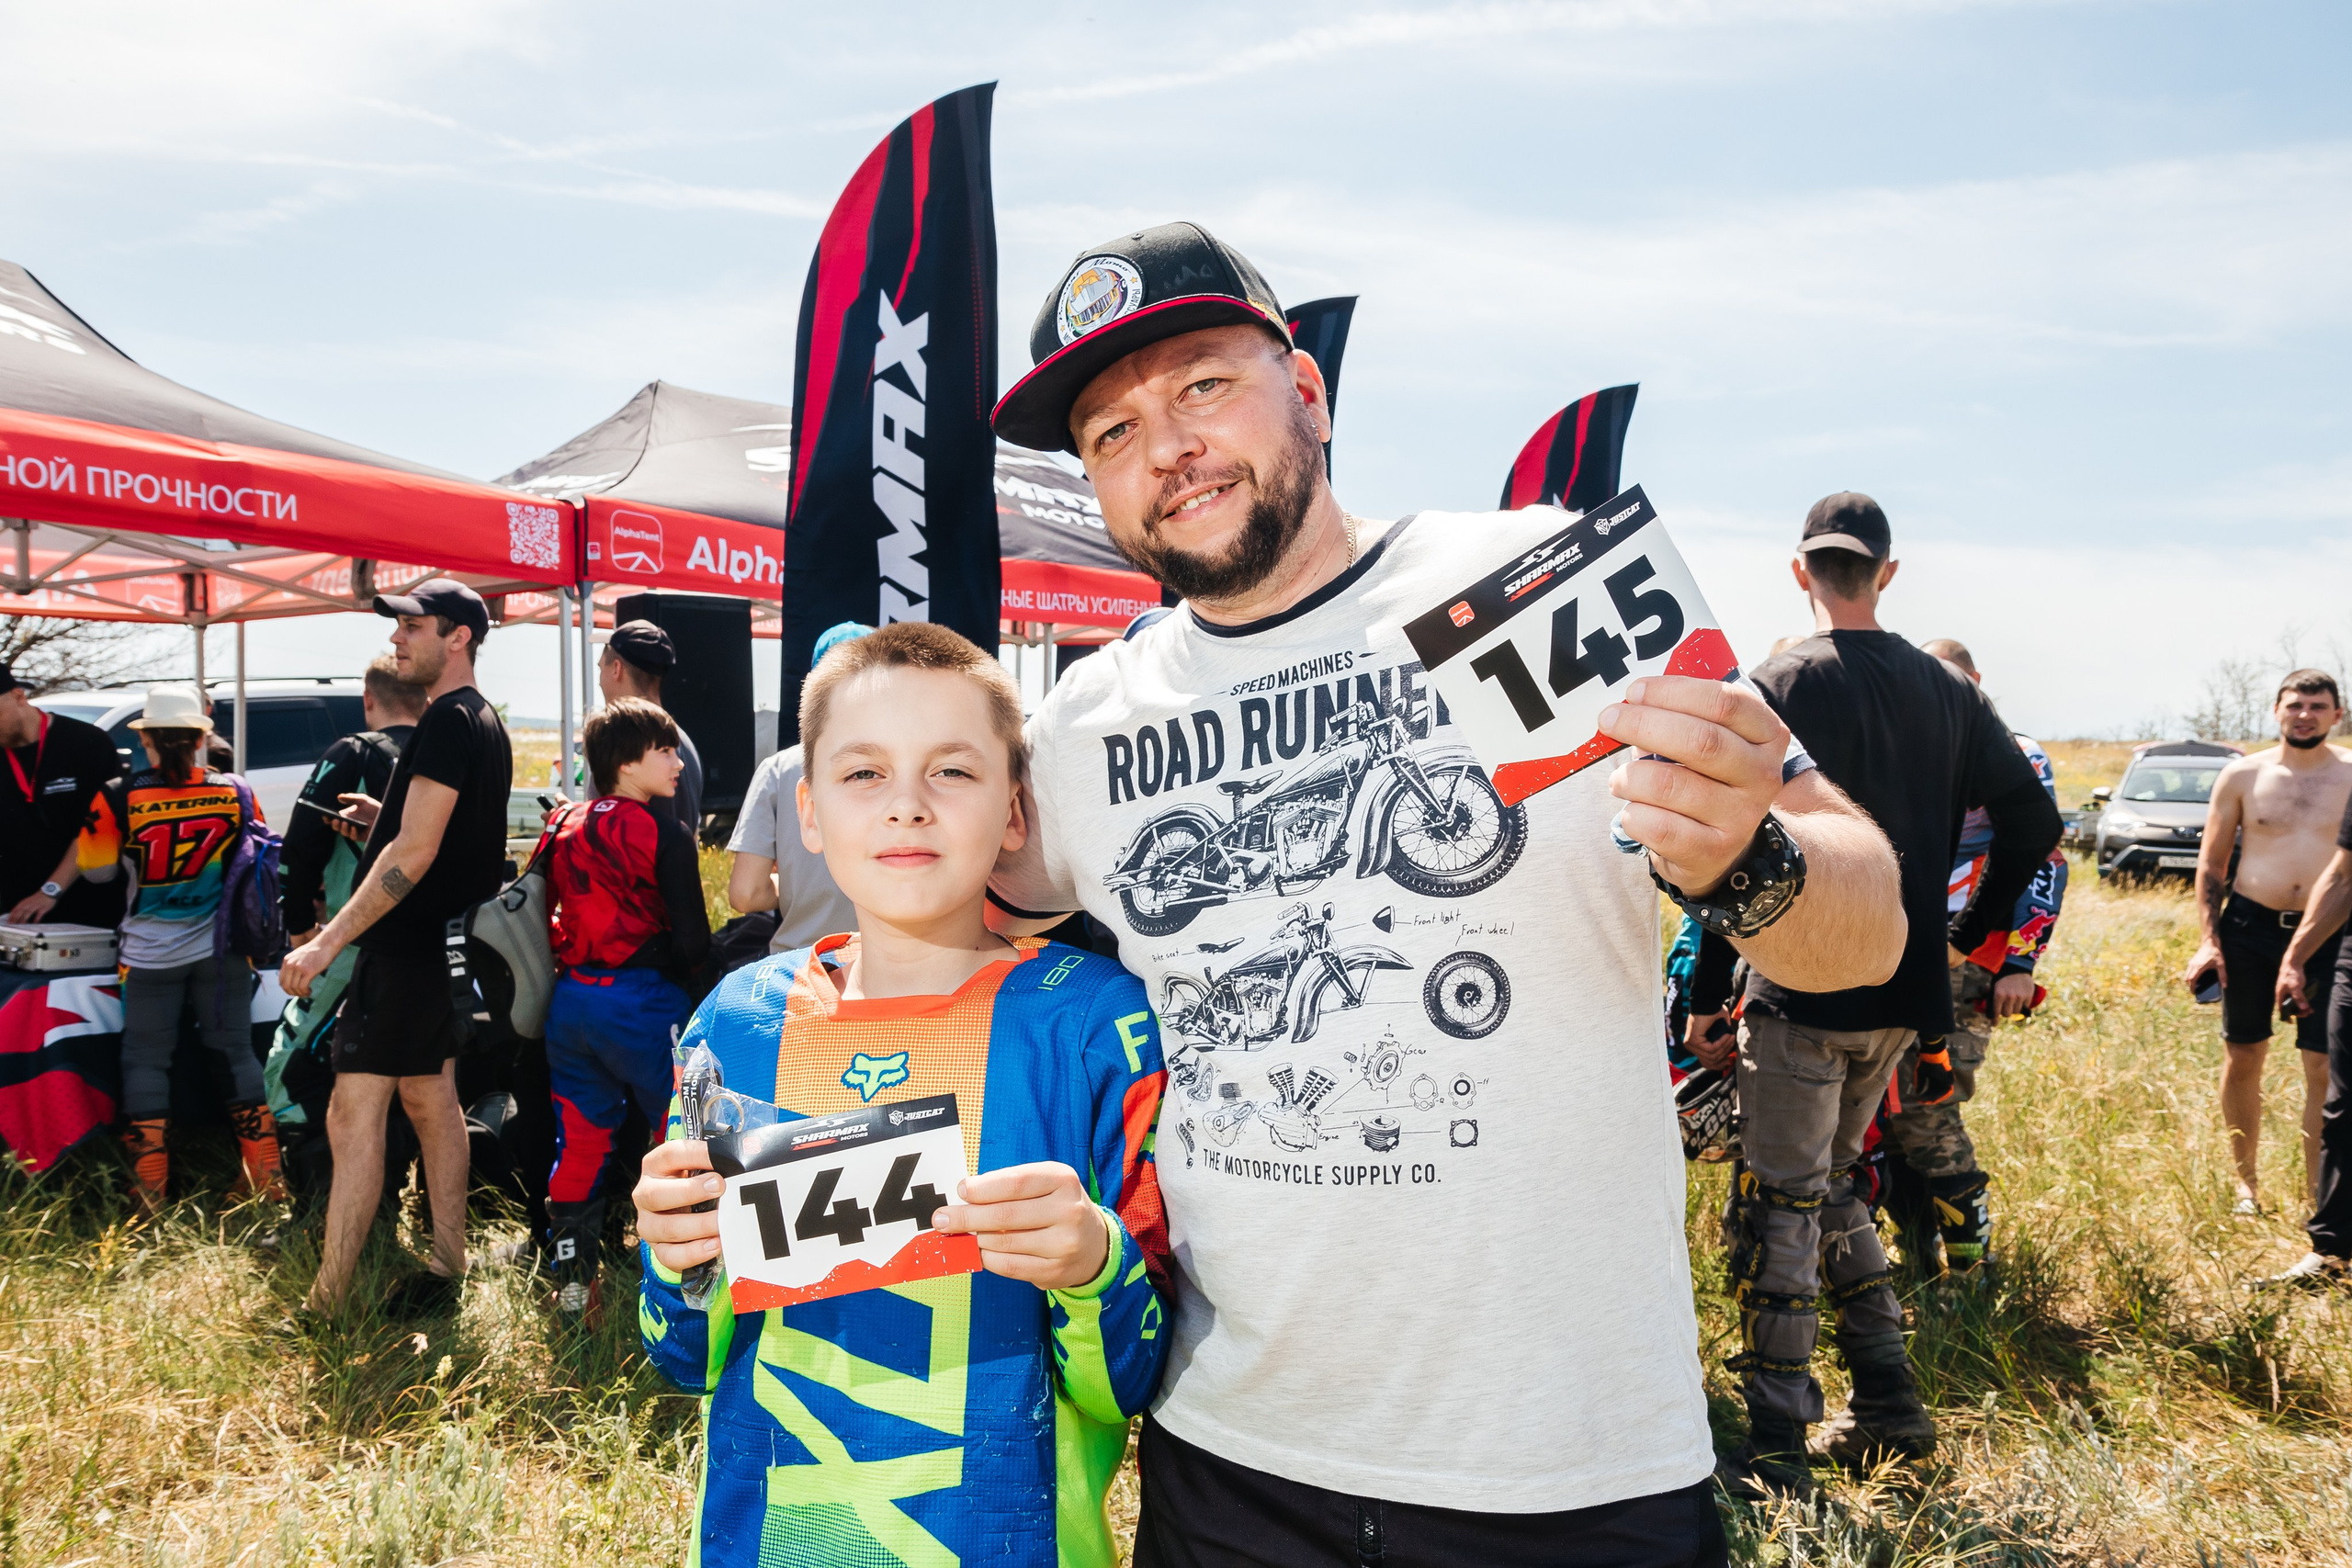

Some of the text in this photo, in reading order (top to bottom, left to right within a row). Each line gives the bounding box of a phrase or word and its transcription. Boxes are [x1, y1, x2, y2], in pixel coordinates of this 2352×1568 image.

[86, 465, 298, 522] ПРОЧНОСТИ
[1020, 502, 1106, 529] MOTO
[614, 525, 661, 543] AlphaTent
[686, 536, 786, 583] Alph
[1504, 542, 1581, 597] SHARMAX
[1555, 553, 1584, 573] MOTORS
[1035, 591, 1089, 614] ШАТРЫ
[1469, 553, 1685, 734] 145
[1229, 650, 1354, 696] SPEED MACHINES
[1102, 708, 1226, 807] ROAD
[138, 817, 229, 882] 17
[1413, 908, 1462, 926] Front light
[1461, 921, 1515, 936] Front wheel
[904, 1107, 945, 1122] JUSTCAT
[790, 1122, 870, 1145] SHARMAX
[840, 1131, 869, 1142] MOTORS
[1203, 1148, 1442, 1186] THE MOTORCYCLE SUPPLY CO.
[739, 1152, 948, 1261] 144
